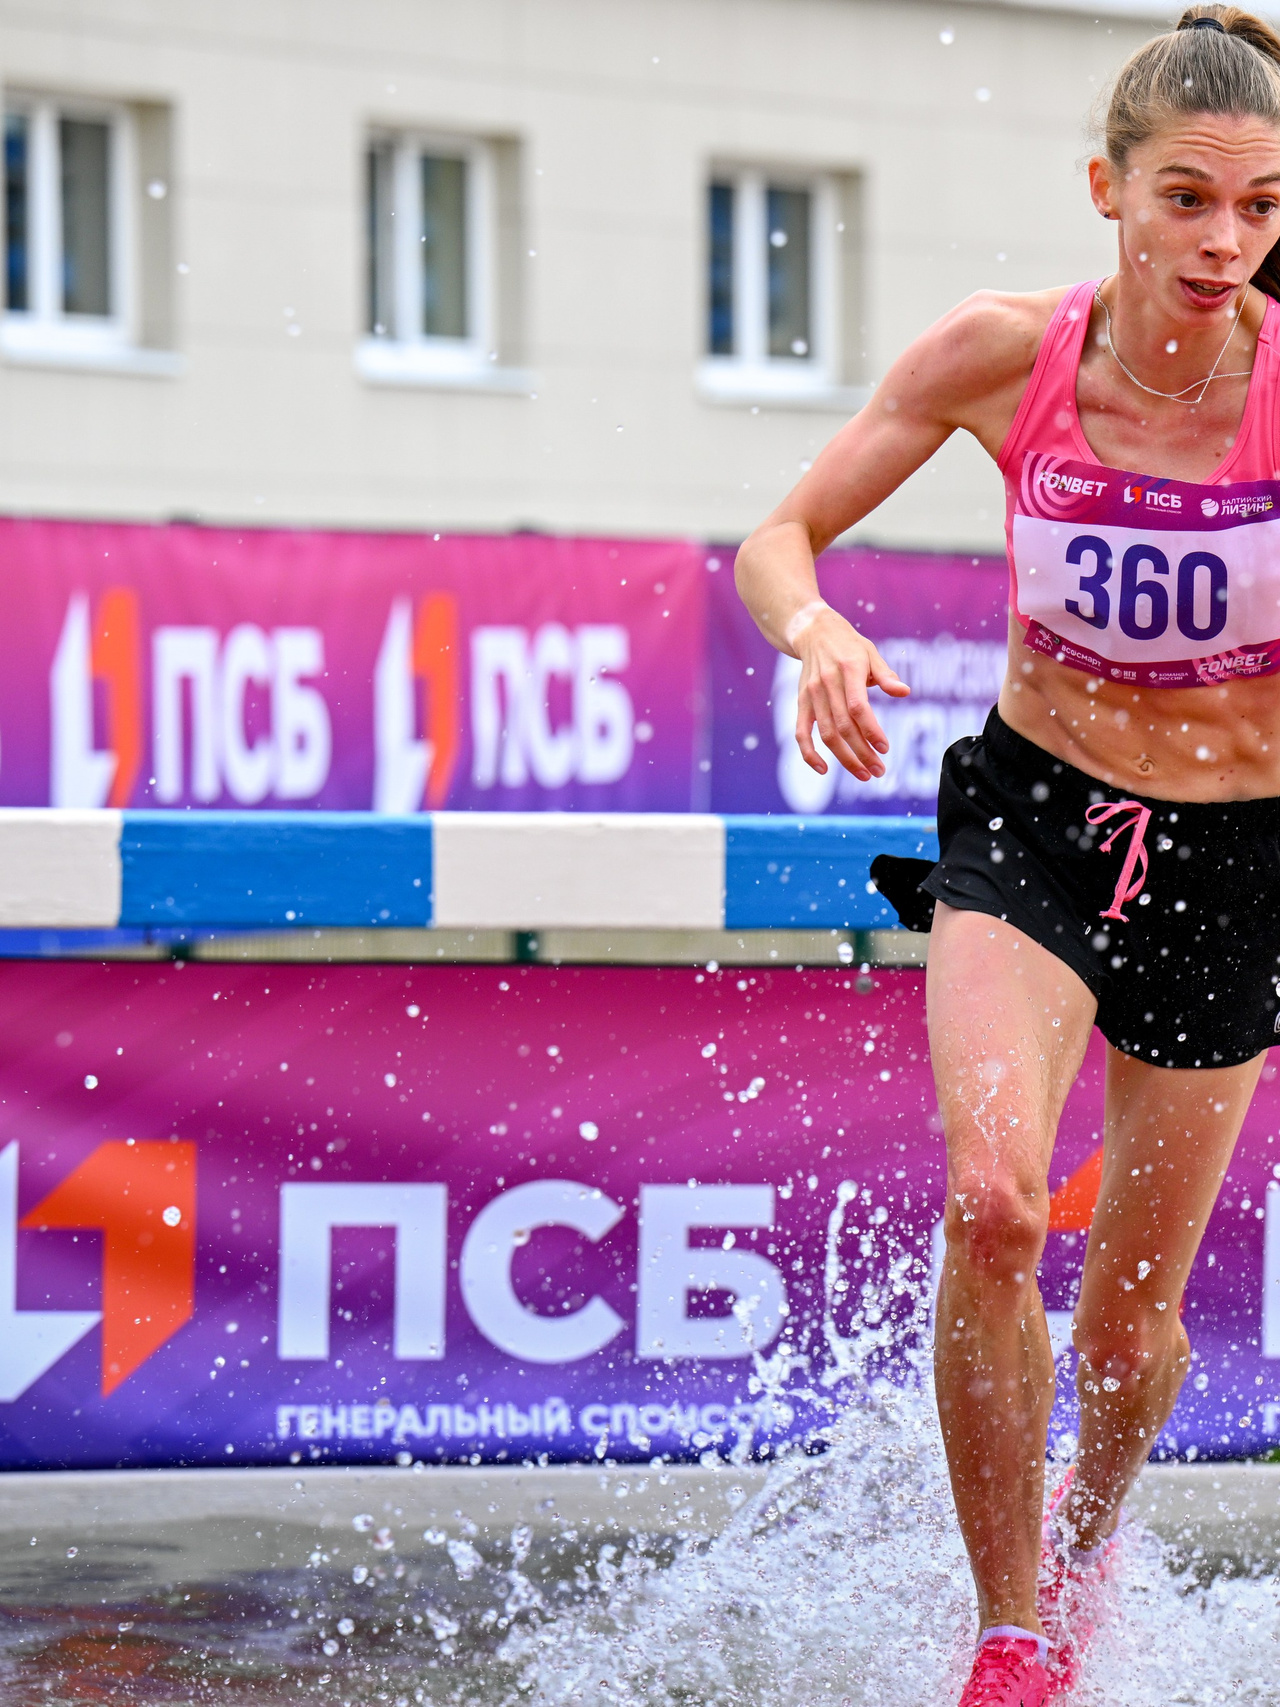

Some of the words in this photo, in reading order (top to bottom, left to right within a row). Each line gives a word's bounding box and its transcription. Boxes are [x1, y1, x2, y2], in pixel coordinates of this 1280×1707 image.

[1036, 471, 1108, 497] FONBET
[1145, 491, 1182, 509] ПСБ
[1221, 494, 1272, 506] БАЛТИЙСКИЙ
[1065, 535, 1228, 641] 360
[1196, 672, 1225, 683] КУБОК
[1197, 652, 1268, 675] FONBET
[152, 623, 332, 803] ПСБ
[470, 622, 635, 790] ПСБ
[278, 1179, 787, 1363] ПСБ
[276, 1397, 571, 1438] ГЕНЕРАЛЬНЫЙ
